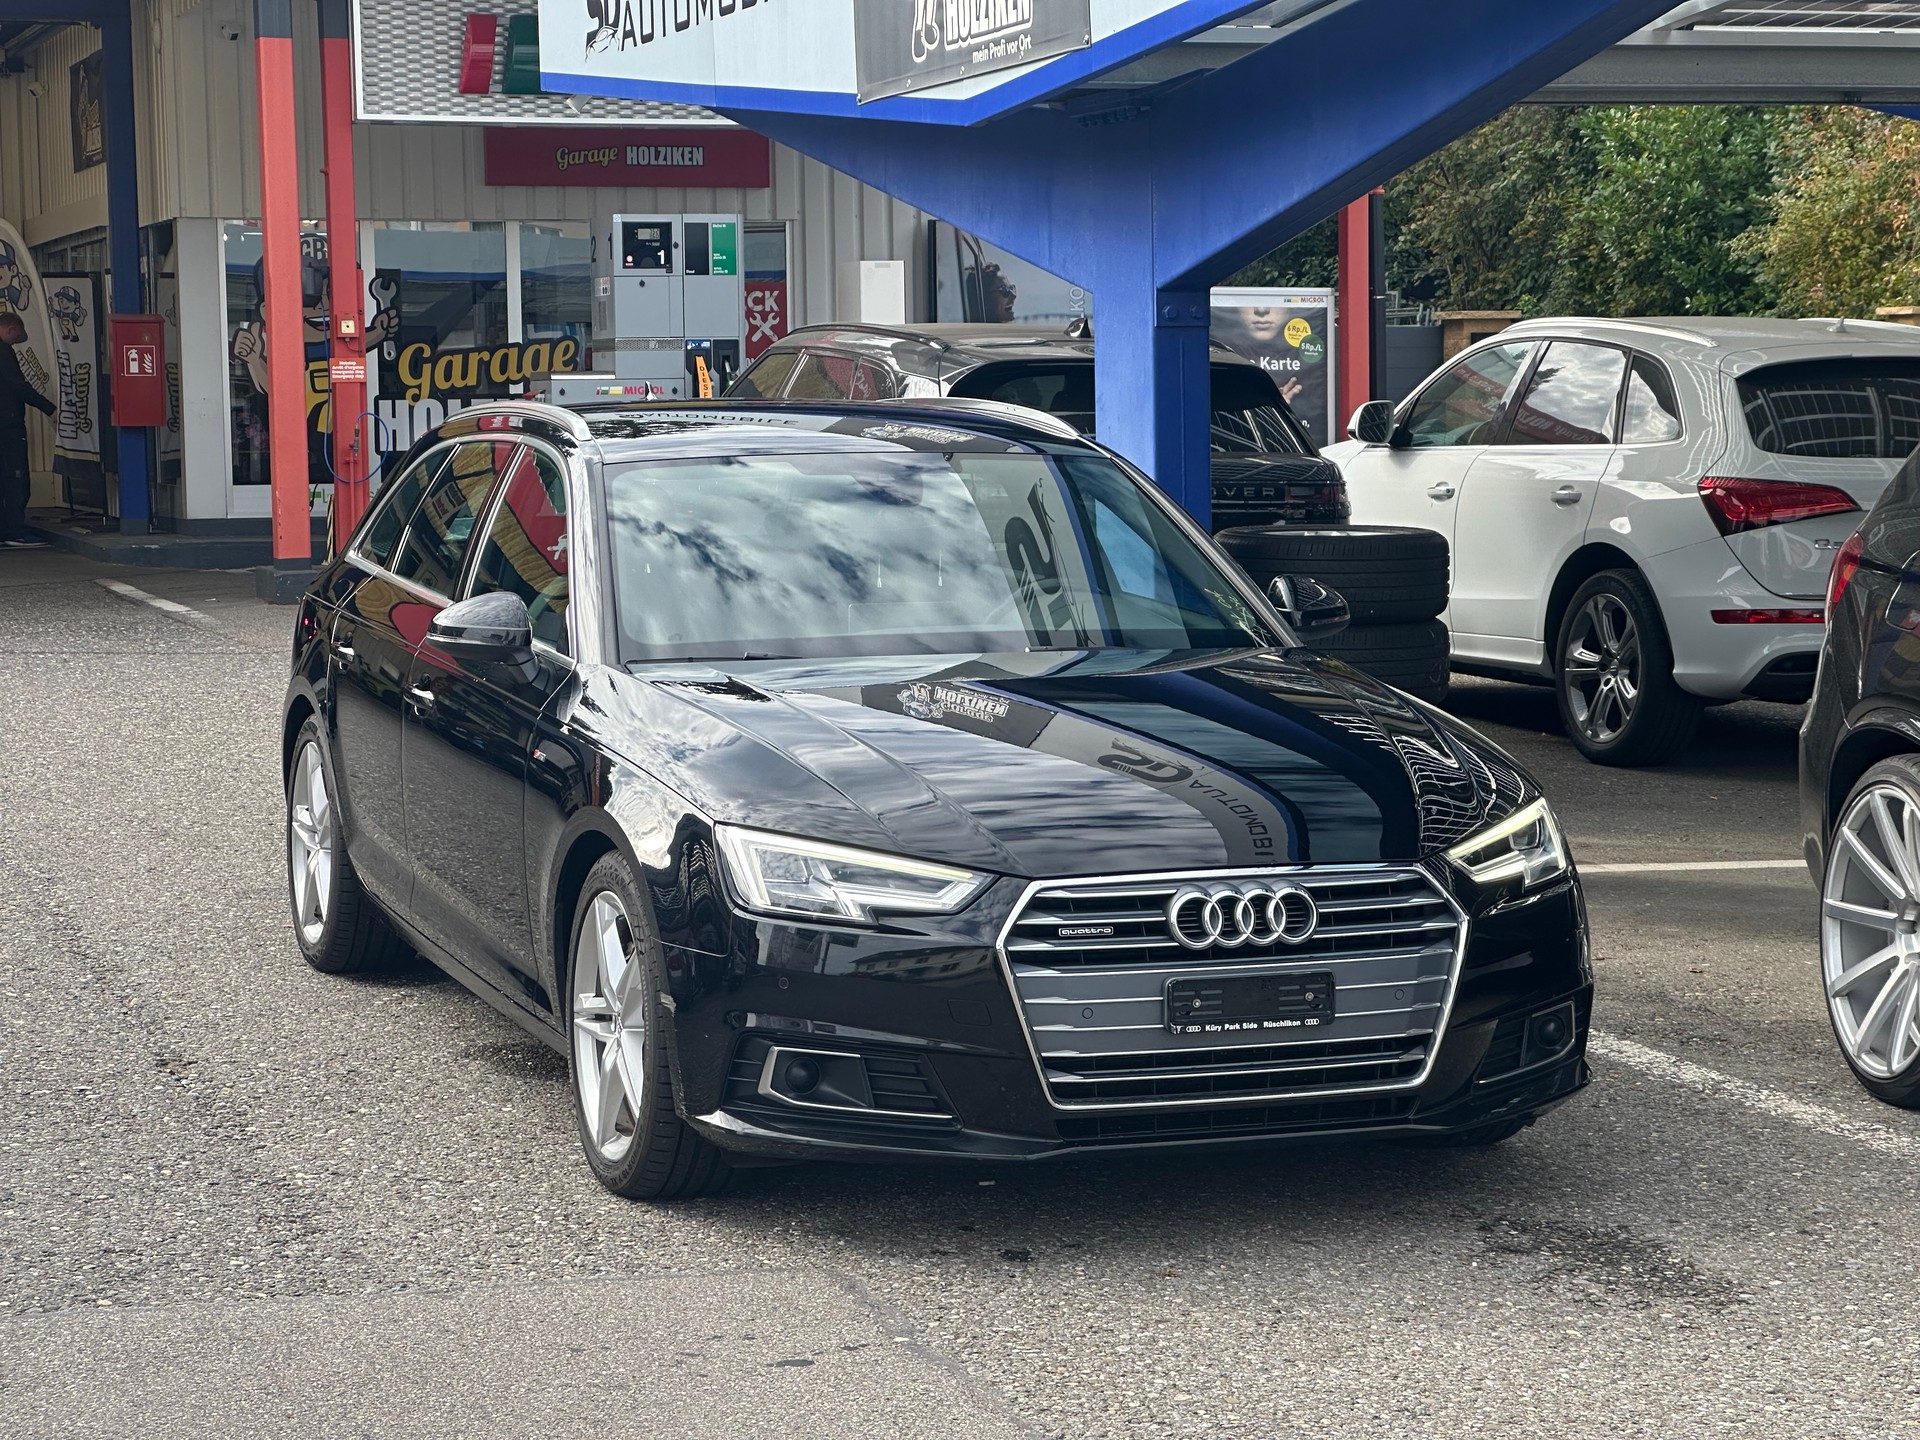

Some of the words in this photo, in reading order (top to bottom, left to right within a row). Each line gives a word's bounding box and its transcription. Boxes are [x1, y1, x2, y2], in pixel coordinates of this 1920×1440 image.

[972, 45, 989, 64] mein
[990, 38, 1006, 59] Profi
[1007, 40, 1018, 56] vor
[1019, 34, 1031, 51] Ort
[556, 147, 618, 170] Garage
[626, 146, 704, 166] HOLZIKEN
[657, 249, 665, 265] 1
[745, 290, 780, 312] CK
[1260, 356, 1301, 370] Karte
[398, 340, 575, 406] Garage
[624, 386, 664, 395] MIGOL
[1061, 928, 1111, 936] quattro
[1205, 1024, 1222, 1032] Küry
[1224, 1023, 1240, 1031] Park
[1243, 1022, 1258, 1030] Side
[1263, 1020, 1300, 1028] Rüschlikon
